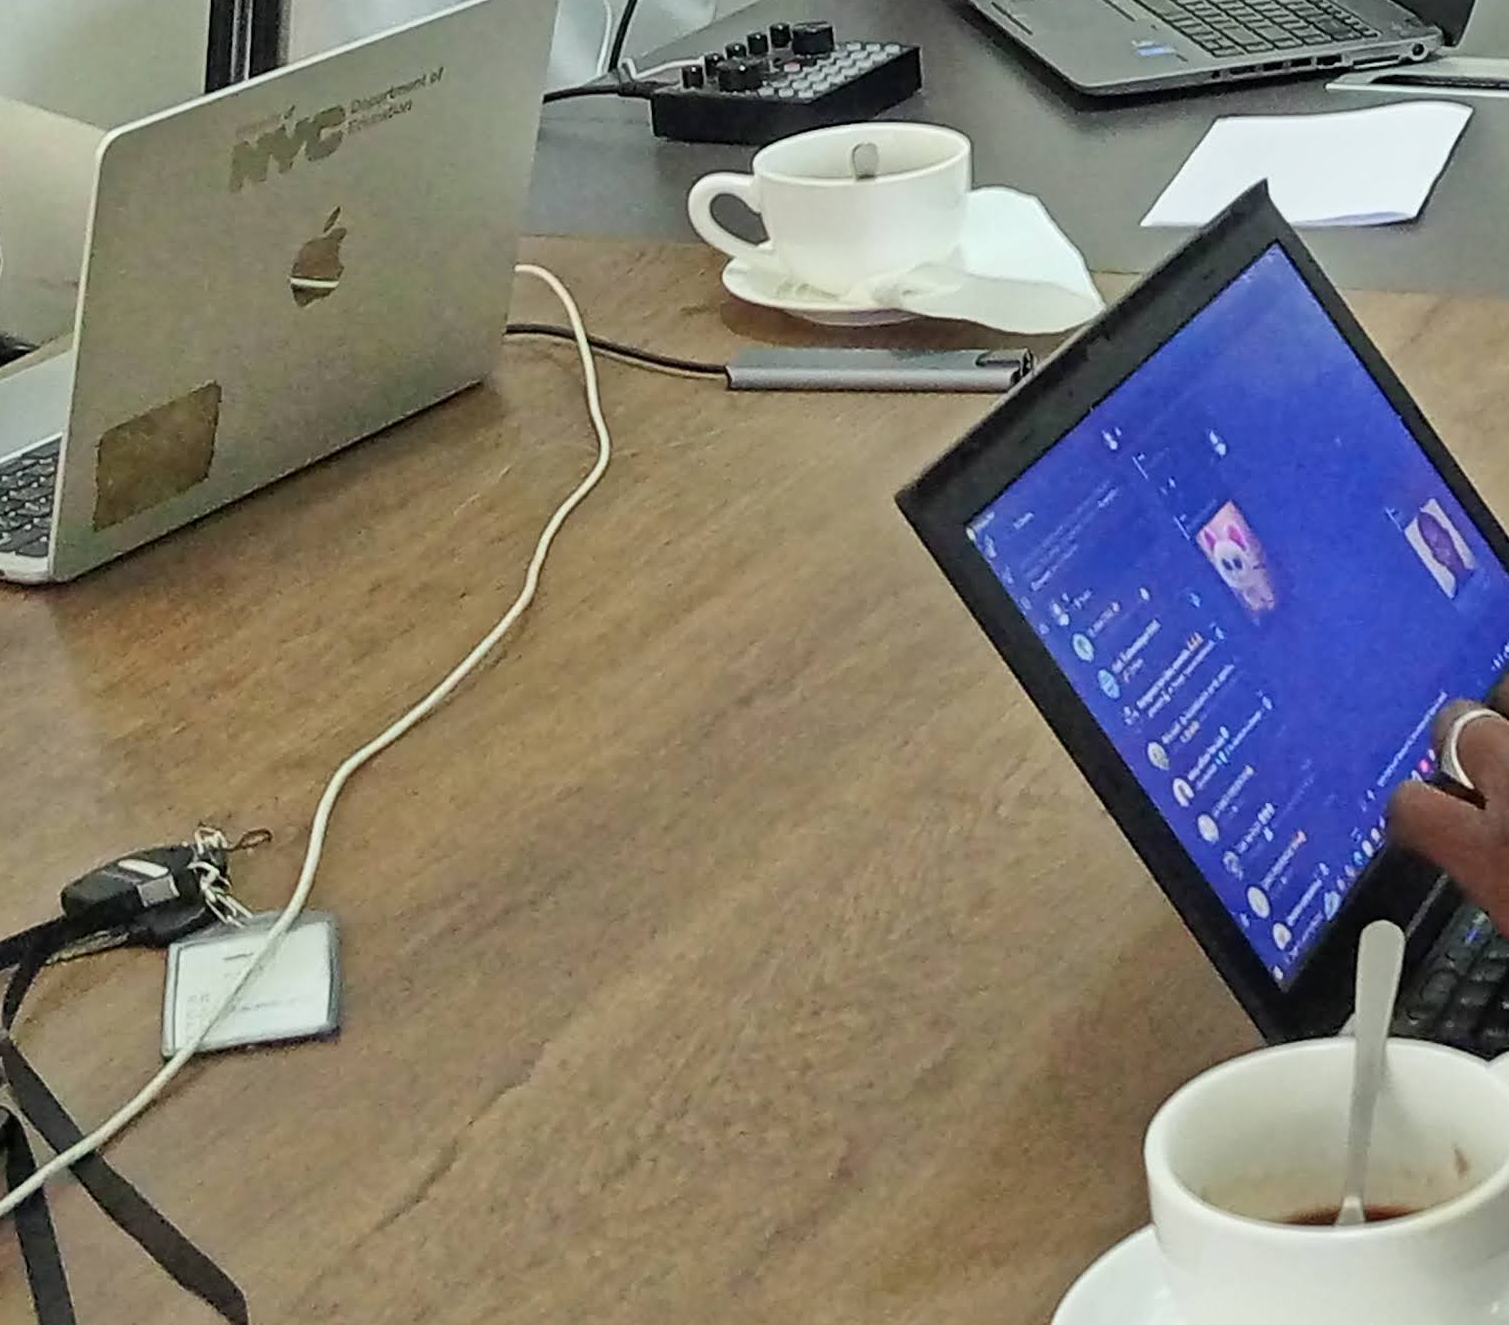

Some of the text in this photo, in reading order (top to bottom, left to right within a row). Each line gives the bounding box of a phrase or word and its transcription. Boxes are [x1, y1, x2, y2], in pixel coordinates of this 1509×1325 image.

[349, 66, 445, 114] Department of
[228, 104, 346, 193] NYC
